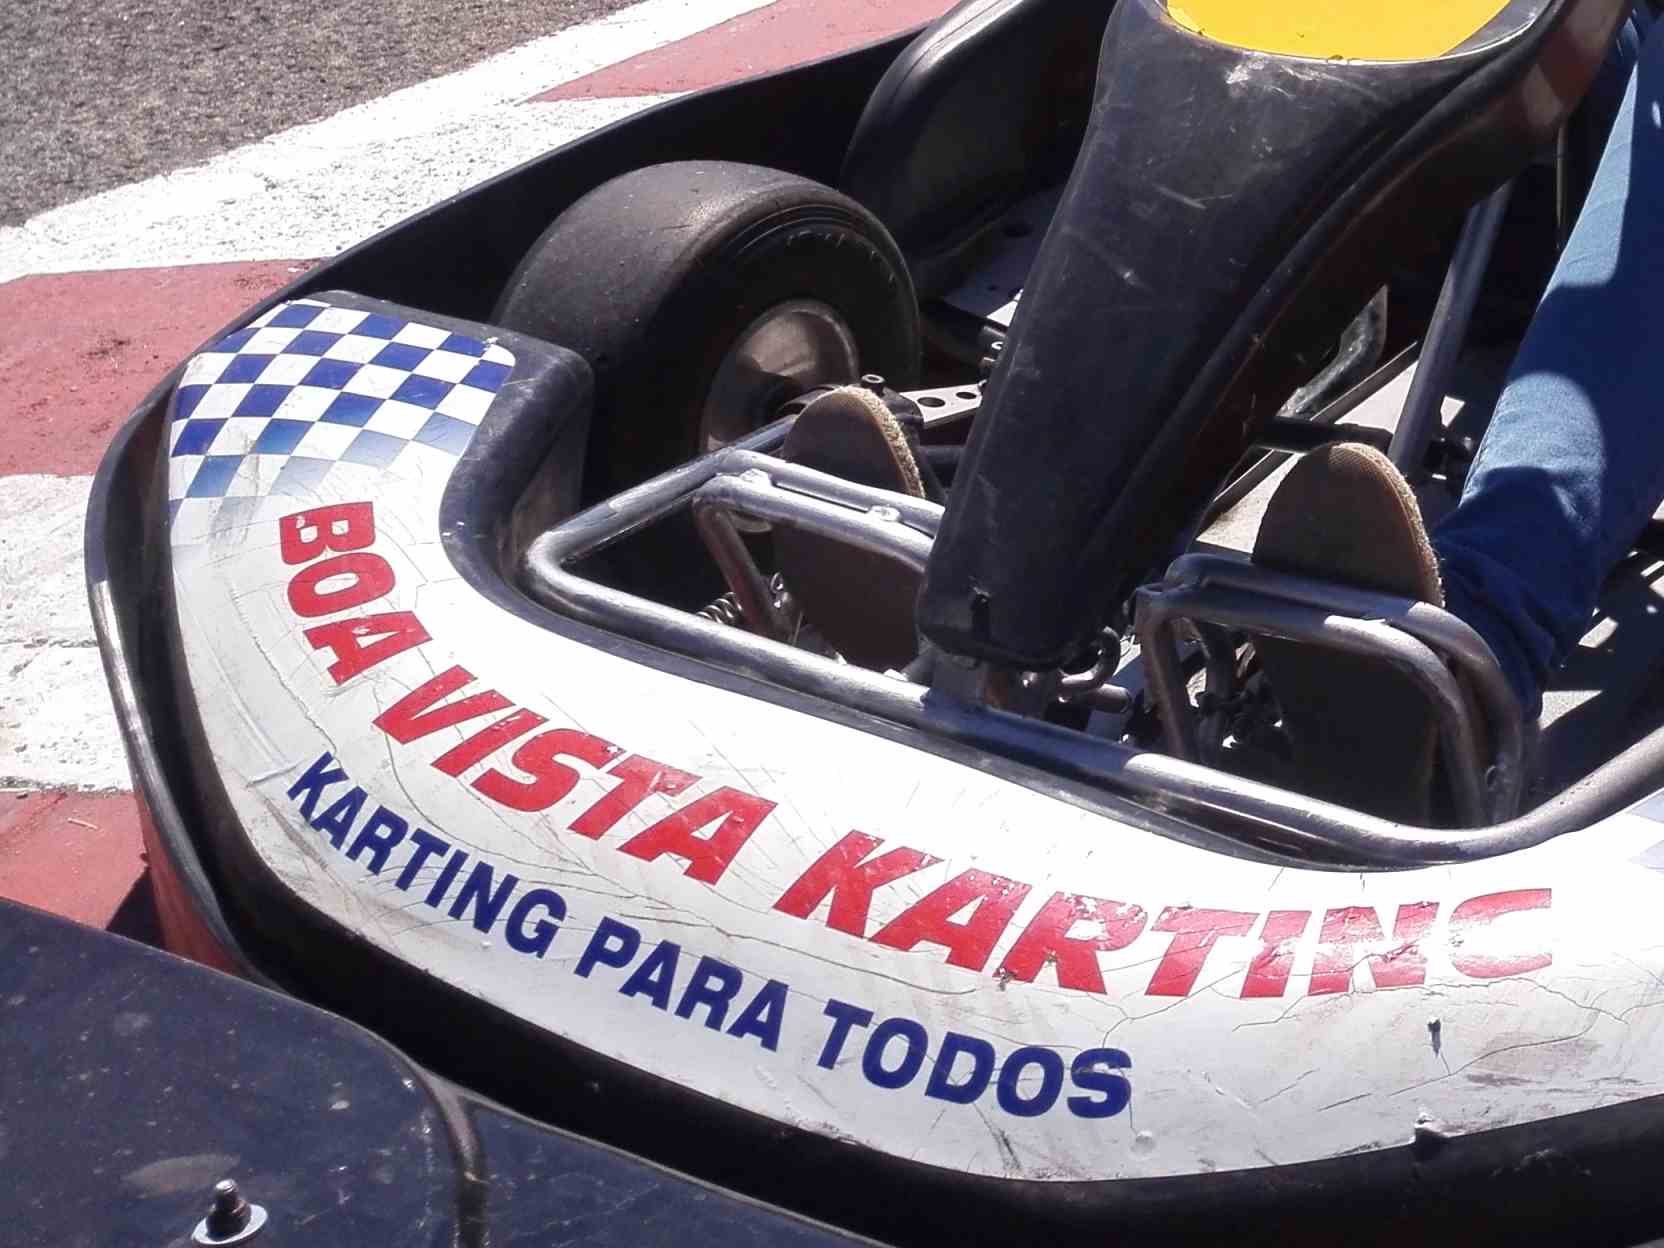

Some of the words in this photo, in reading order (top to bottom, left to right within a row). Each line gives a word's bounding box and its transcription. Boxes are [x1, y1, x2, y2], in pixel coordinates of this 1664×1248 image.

[279, 501, 432, 686] BOA
[372, 664, 778, 885] VISTA
[773, 830, 1553, 1000] KARTING
[286, 752, 568, 960] KARTING
[574, 917, 789, 1053] PARA
[817, 998, 1133, 1120] TODOS
